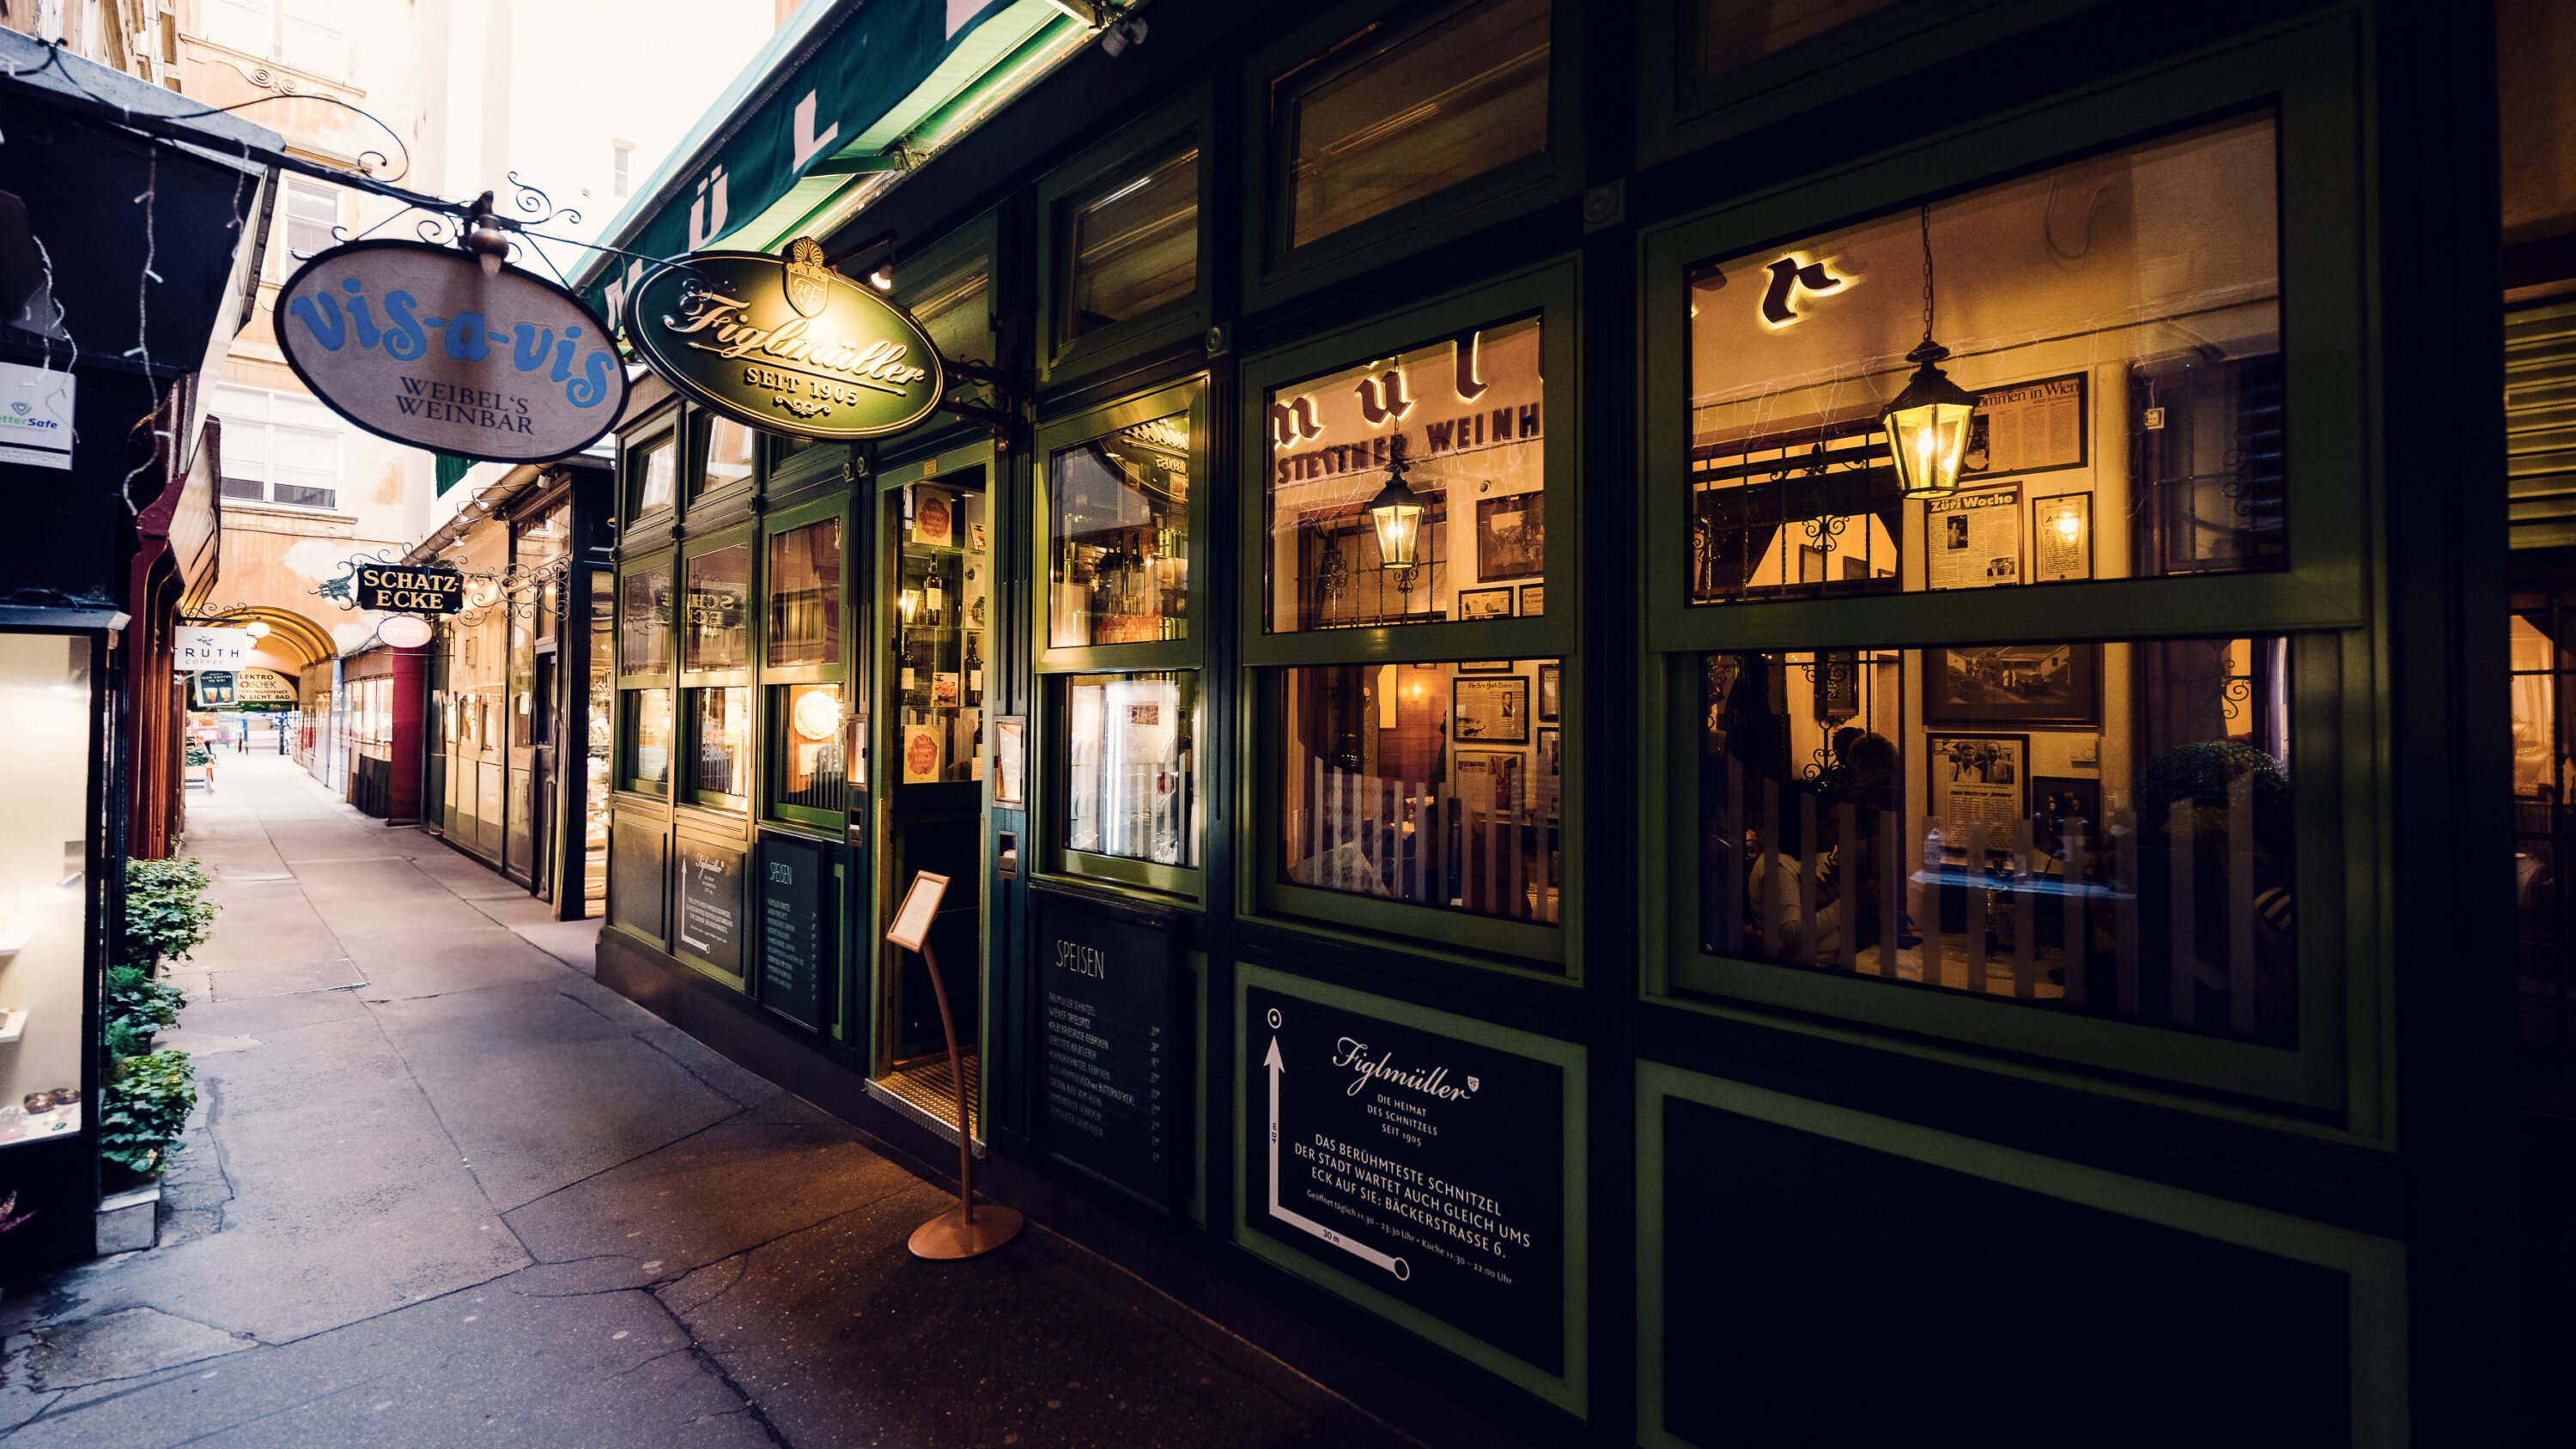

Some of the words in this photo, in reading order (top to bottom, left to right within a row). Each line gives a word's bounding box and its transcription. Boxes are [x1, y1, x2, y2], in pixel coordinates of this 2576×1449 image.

[290, 277, 613, 409] vis-a-vis
[661, 291, 925, 385] Figlmüller
[401, 376, 528, 415] WEIBEL'S
[745, 367, 799, 392] SEIT
[811, 382, 858, 406] 1905
[1978, 391, 2026, 408] ommen
[2030, 388, 2042, 400] in
[2044, 380, 2080, 397] Wien
[396, 395, 534, 434] WEINBAR
[1930, 500, 1963, 512] Züri
[1963, 493, 2013, 508] Woche
[363, 569, 459, 592] SCHATZ-
[376, 590, 444, 609] ECKE
[769, 862, 793, 885] SPEISEN
[1056, 940, 1104, 979] SPEISEN
[1333, 1036, 1471, 1101] Figlmüller
[1367, 1104, 1382, 1117] DES
[1385, 1109, 1438, 1137] SCHNITZELS
[1377, 1094, 1391, 1106] DIE
[1394, 1099, 1427, 1118] HEIMAT
[1382, 1123, 1399, 1137] SEIT
[1402, 1131, 1422, 1147] 1905
[1315, 1133, 1336, 1151] DAS
[1340, 1142, 1424, 1185] BERÜHMTESTE
[1428, 1176, 1502, 1216] SCHNITZEL
[1295, 1143, 1315, 1161] DER
[1318, 1152, 1352, 1175] STADT
[1355, 1161, 1401, 1196] WARTET
[1404, 1186, 1440, 1211] AUCH
[1443, 1203, 1494, 1234] GLEICH
[1498, 1224, 1531, 1248] UMS
[1311, 1166, 1333, 1185] ECK
[1335, 1177, 1357, 1195] AUF
[1360, 1186, 1382, 1206] SIE:
[1385, 1196, 1489, 1252] BÄCKERSTRASSE
[1493, 1241, 1506, 1259] 6.
[1307, 1188, 1333, 1208] Geöffnet
[1334, 1199, 1357, 1217] täglich
[1358, 1213, 1374, 1226] 11:30
[1381, 1222, 1400, 1237] 23:30
[1401, 1227, 1415, 1242] Uhr
[1421, 1238, 1444, 1257] Küche
[1446, 1252, 1465, 1266] 11:30
[1473, 1262, 1495, 1278] 22:00
[1497, 1270, 1513, 1285] Uhr
[1323, 1229, 1332, 1240] 30
[1333, 1234, 1340, 1244] m
